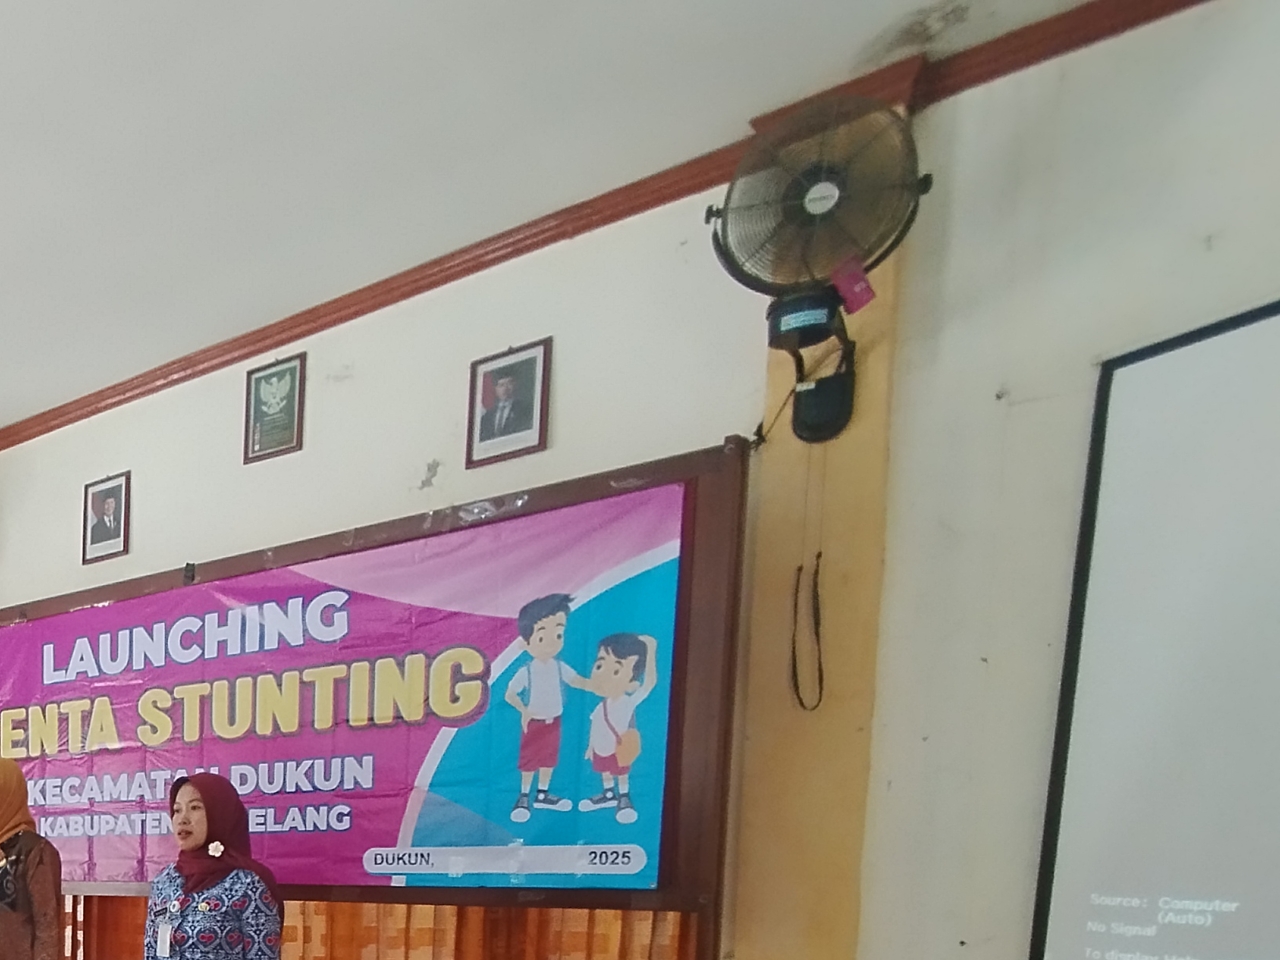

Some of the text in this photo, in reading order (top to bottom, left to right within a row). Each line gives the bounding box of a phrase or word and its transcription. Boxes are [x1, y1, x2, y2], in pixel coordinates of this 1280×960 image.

[42, 590, 351, 685] LAUNCHING
[136, 647, 485, 748] STUNTING
[27, 755, 374, 806] KECAMAT DUKUN
[248, 804, 352, 833] ELANG
[373, 850, 632, 868] DUKUN, 2025
[1158, 897, 1241, 912] Computer
[1157, 911, 1213, 927] (Auto)
[1086, 921, 1157, 937] No Signal
[1085, 948, 1101, 960] To
